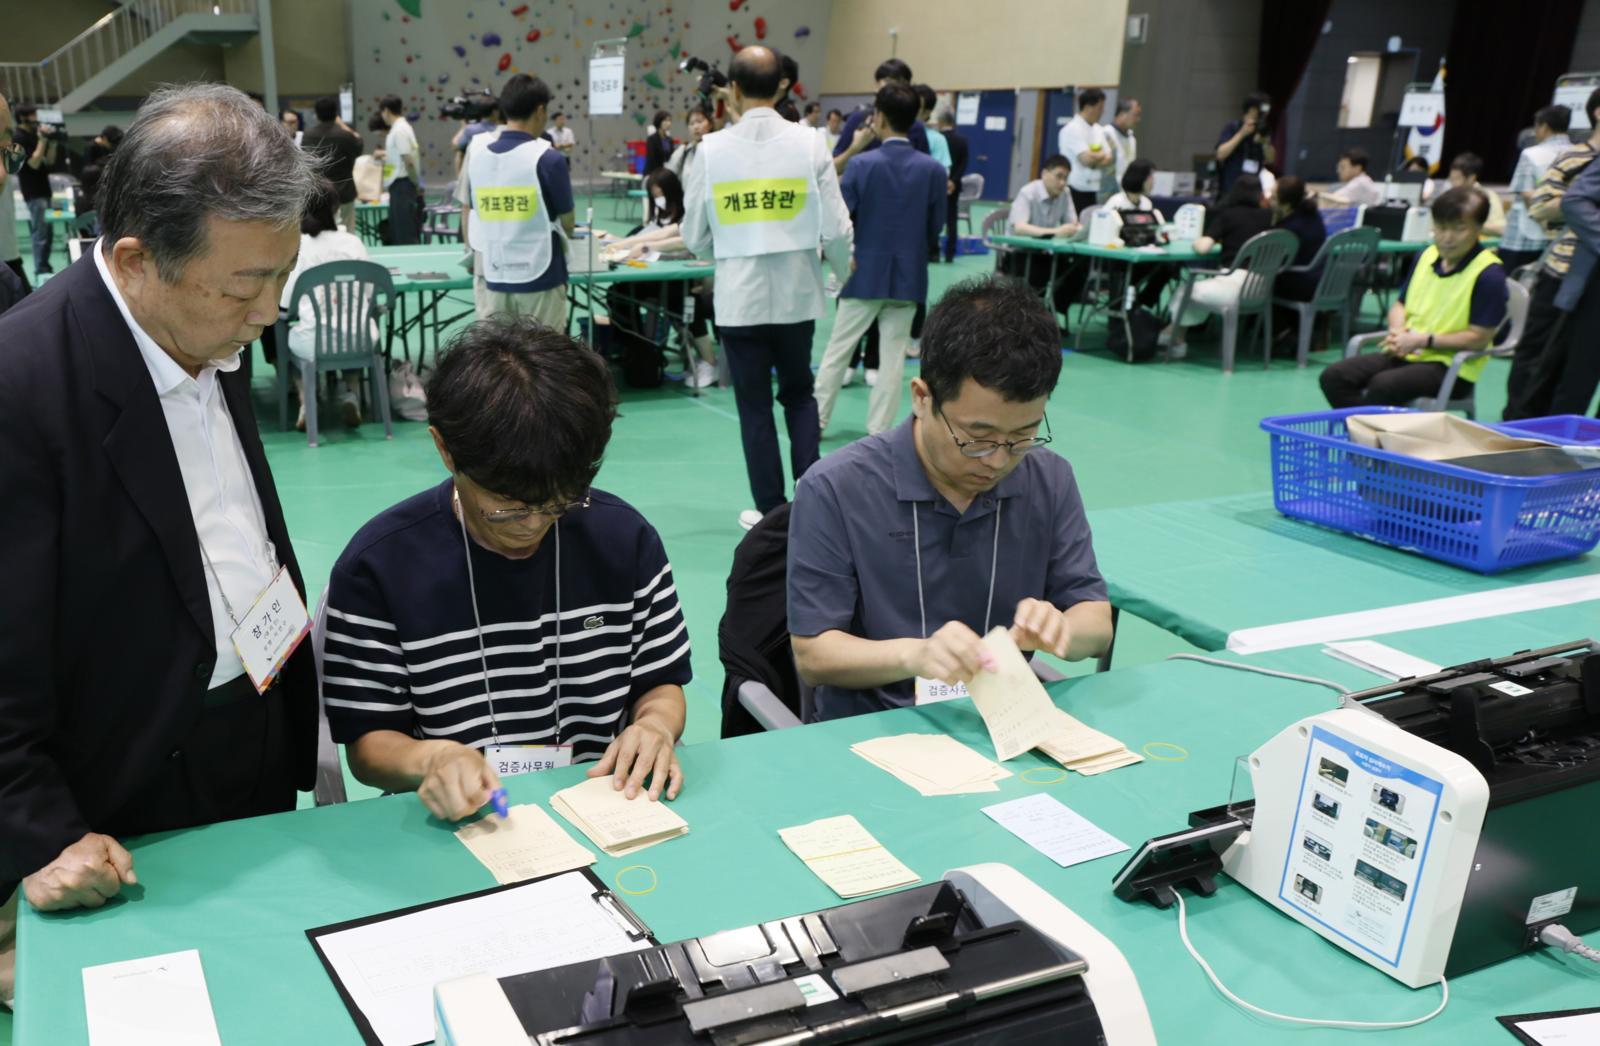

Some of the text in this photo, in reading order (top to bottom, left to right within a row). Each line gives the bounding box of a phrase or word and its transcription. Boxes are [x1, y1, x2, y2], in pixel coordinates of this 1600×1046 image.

[480, 195, 529, 212] 개표참관
[723, 189, 796, 213] 개표참관
[499, 761, 554, 773] 검증사무원
